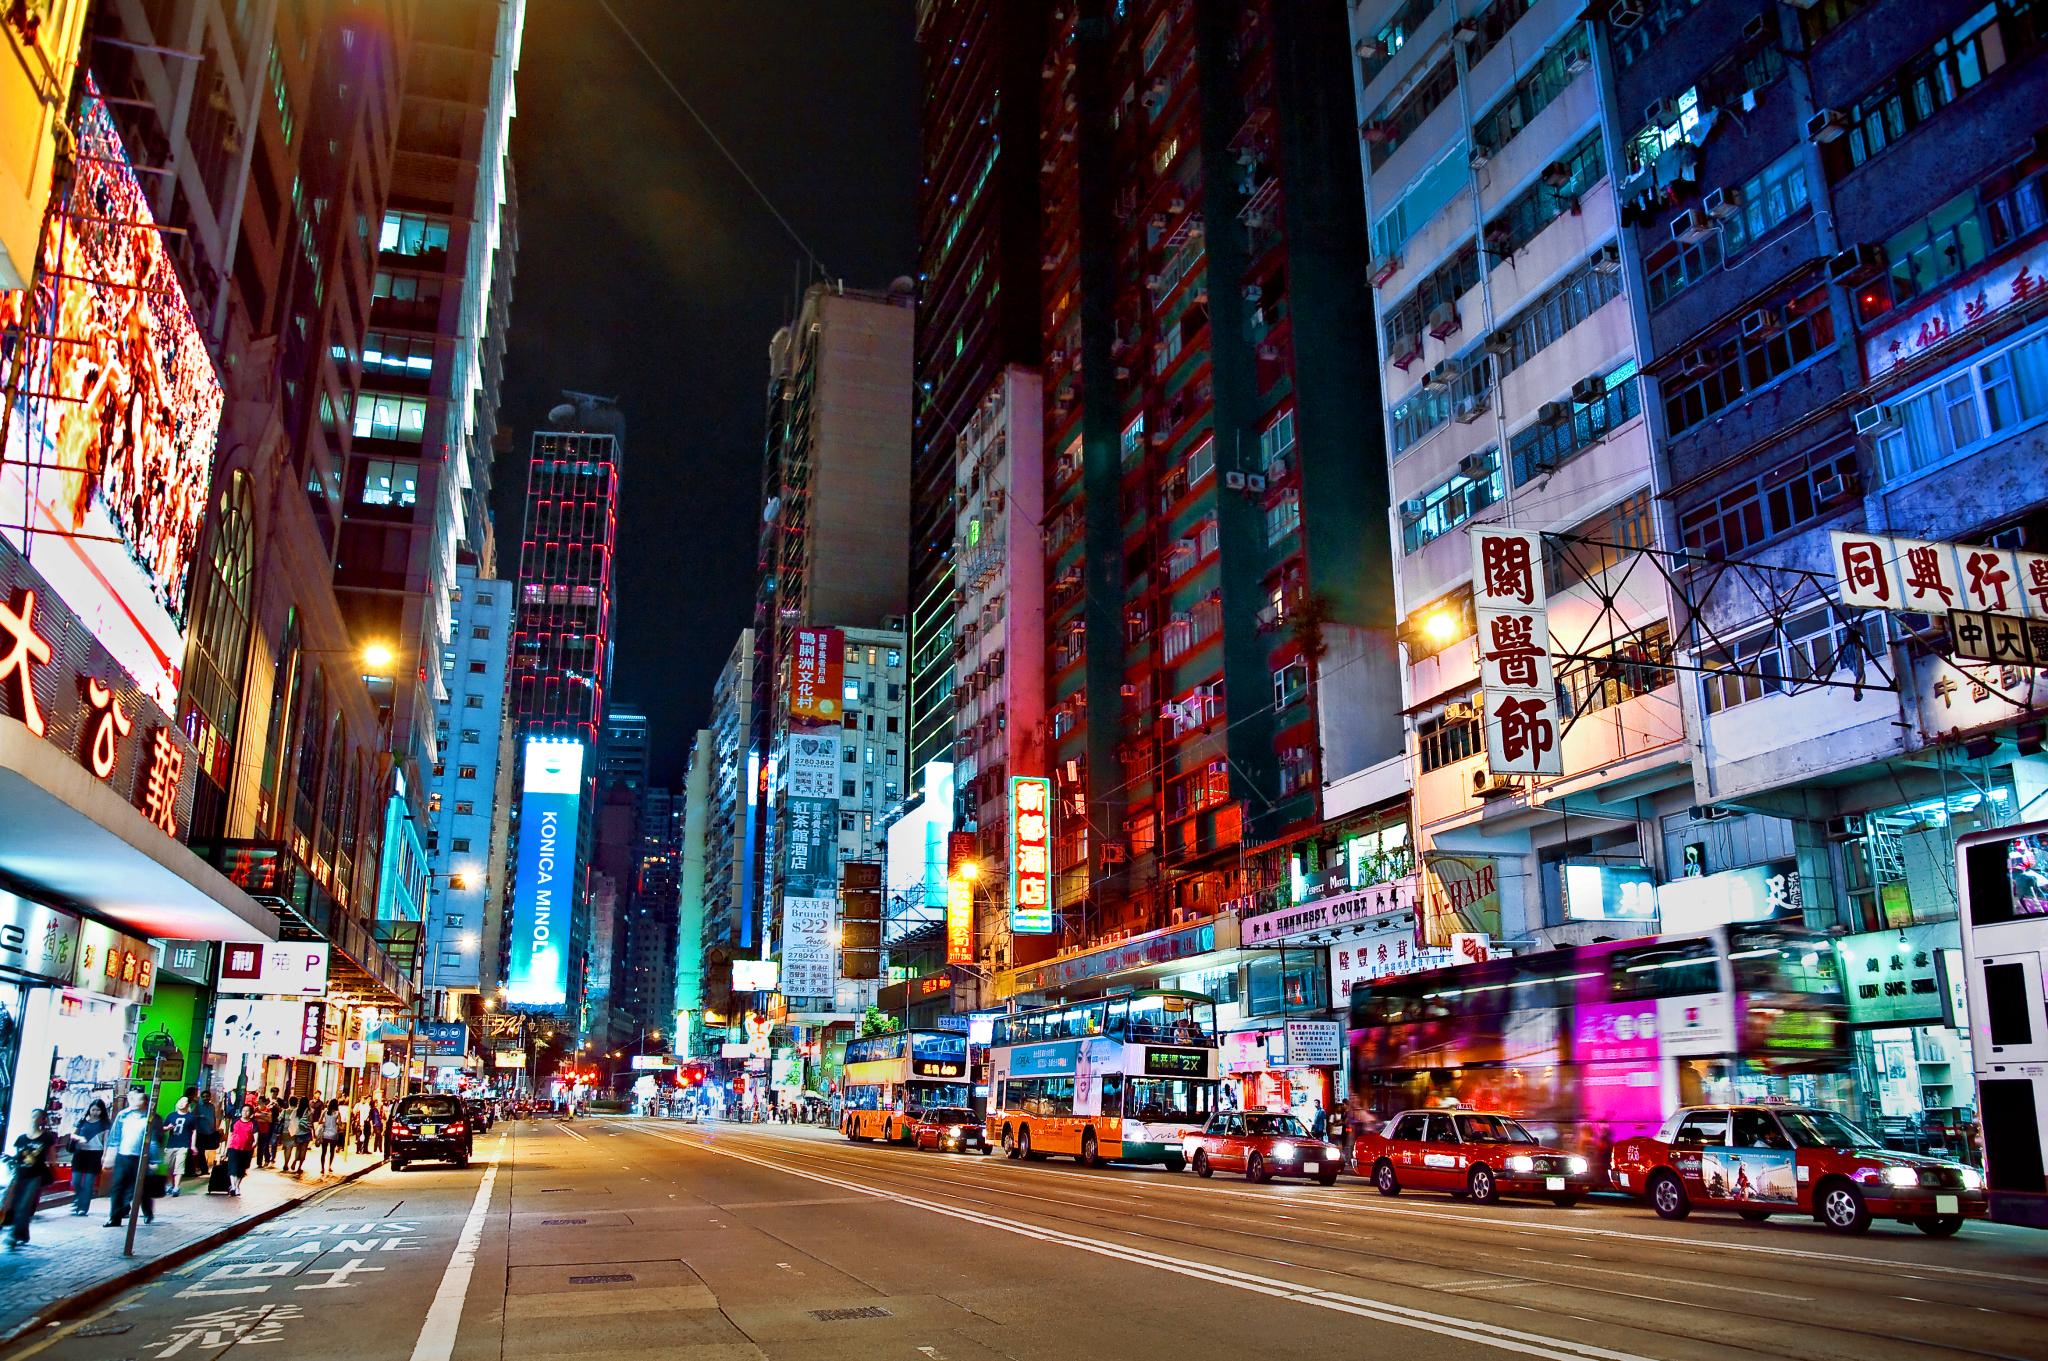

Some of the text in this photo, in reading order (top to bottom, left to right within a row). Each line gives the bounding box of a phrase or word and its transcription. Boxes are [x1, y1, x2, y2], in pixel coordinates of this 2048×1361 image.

[791, 801, 810, 870] 紅茶館酒店
[537, 811, 557, 885] KONICA
[1432, 865, 1496, 921] V-HAIR
[791, 910, 828, 919] Brunch
[1277, 907, 1327, 930] HENNESSY
[1332, 897, 1367, 917] COURT
[792, 919, 828, 934] $22
[305, 955, 320, 972] P
[1182, 1060, 1198, 1071] 2X
[1627, 1153, 1640, 1161] TAXI
[278, 1222, 422, 1237] BUS
[223, 1236, 427, 1258] LANE
[174, 1258, 386, 1298] 巴士
